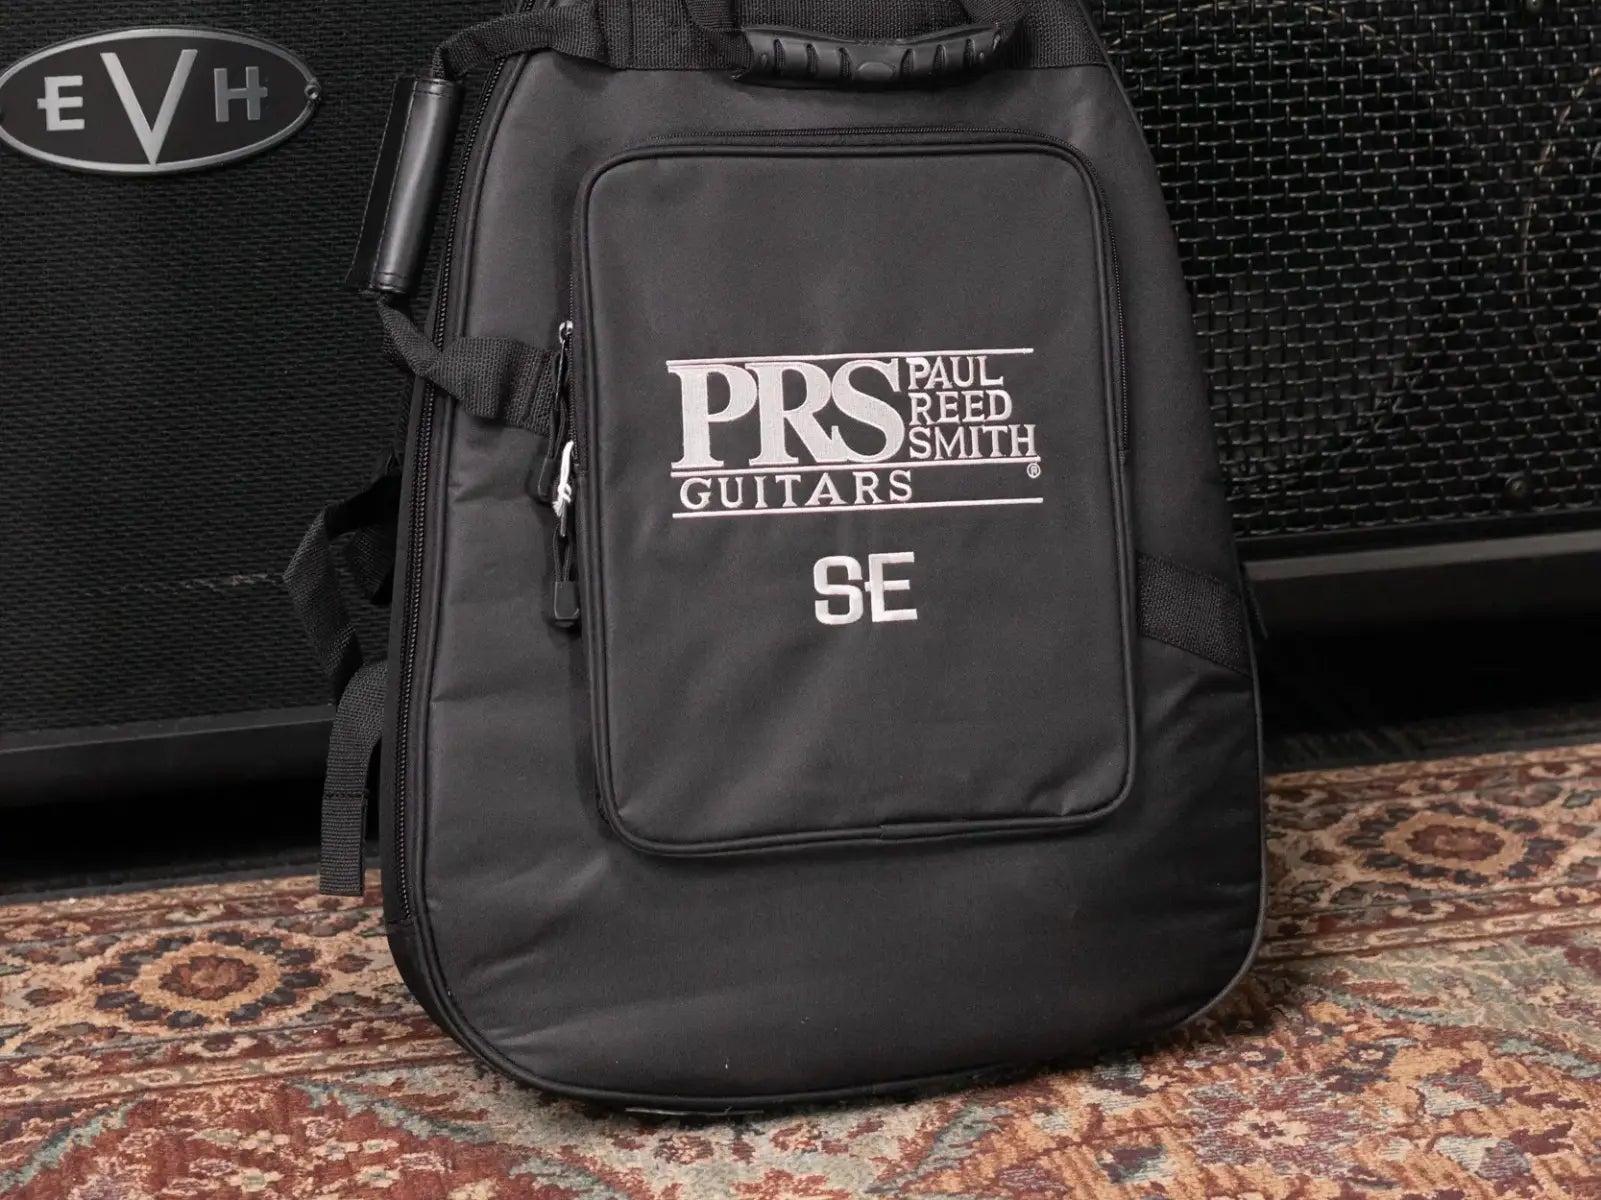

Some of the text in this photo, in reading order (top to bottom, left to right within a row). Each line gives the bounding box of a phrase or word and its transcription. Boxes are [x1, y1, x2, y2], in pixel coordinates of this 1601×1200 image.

[36, 48, 269, 166] EVH
[905, 355, 1004, 392] PAUL
[667, 357, 906, 470] PRS
[907, 388, 1014, 426] REED
[908, 423, 1037, 461] SMITH
[678, 469, 914, 511] GUITARS
[812, 550, 919, 626] SE
